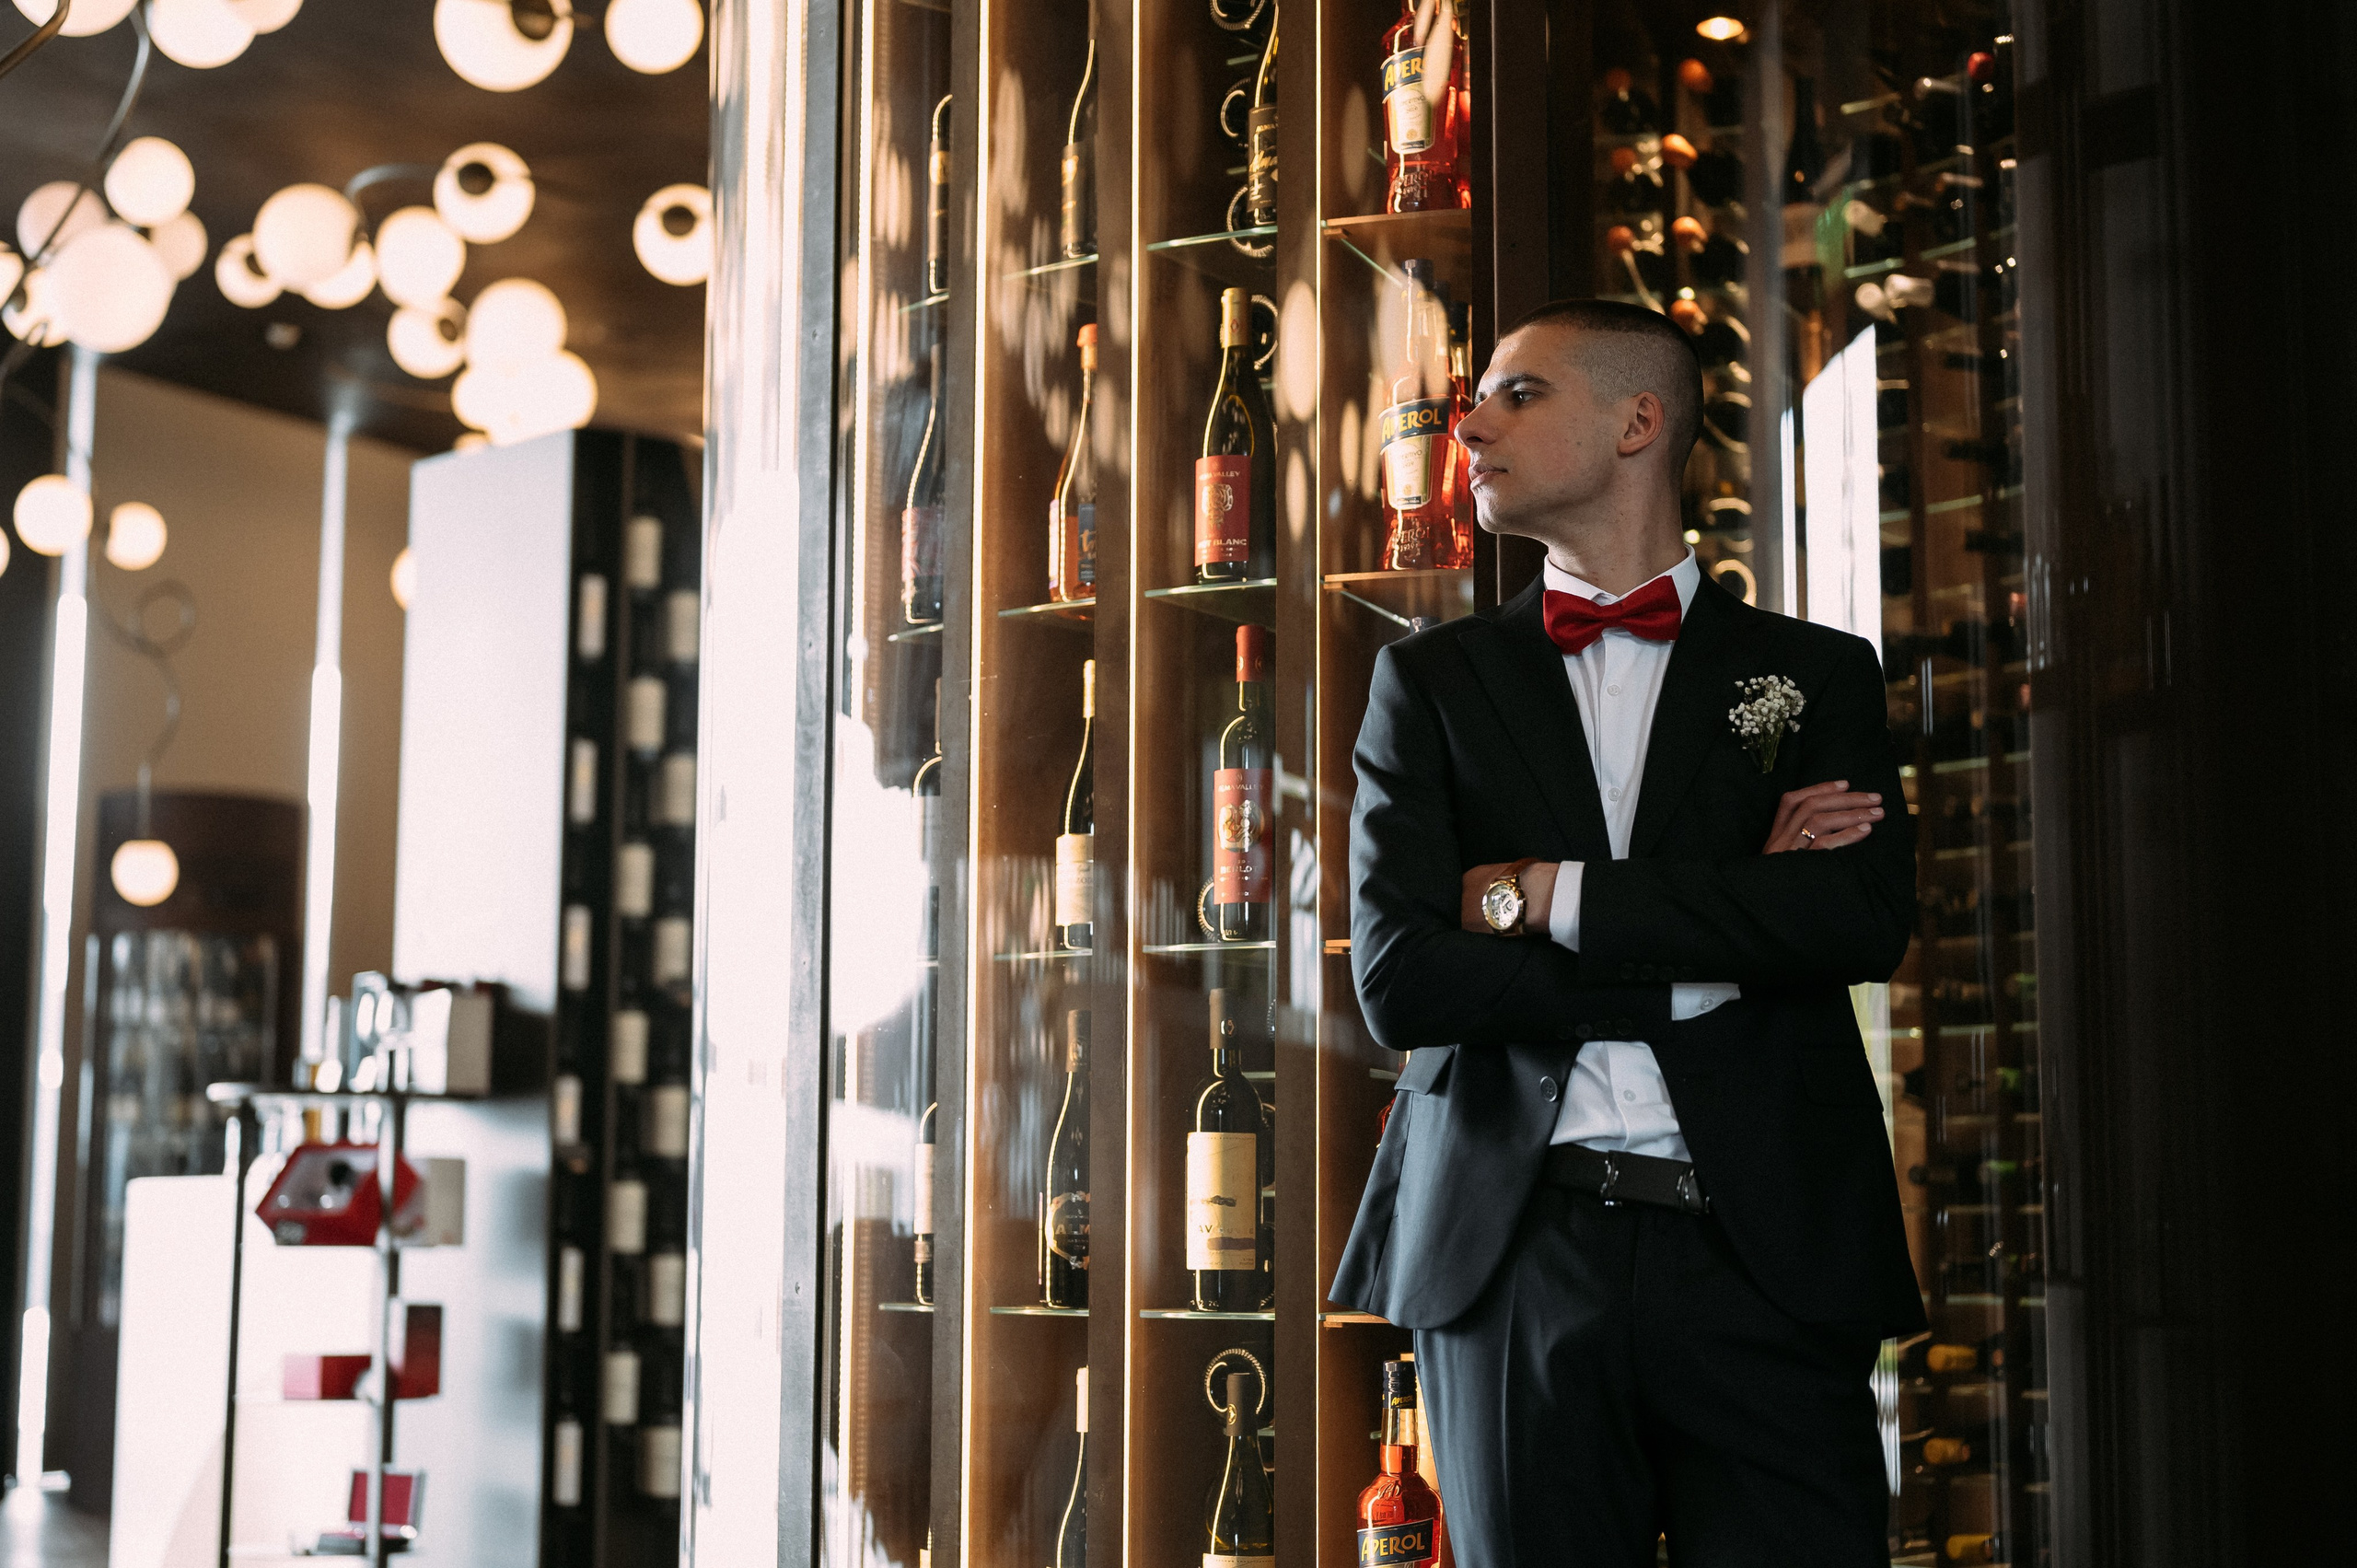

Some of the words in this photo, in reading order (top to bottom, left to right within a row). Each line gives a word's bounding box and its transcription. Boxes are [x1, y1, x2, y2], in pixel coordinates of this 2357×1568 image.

[1384, 57, 1426, 92] APER
[1381, 408, 1442, 444] APEROL
[1213, 538, 1248, 547] BLANC
[1361, 1532, 1425, 1562] APEROL
